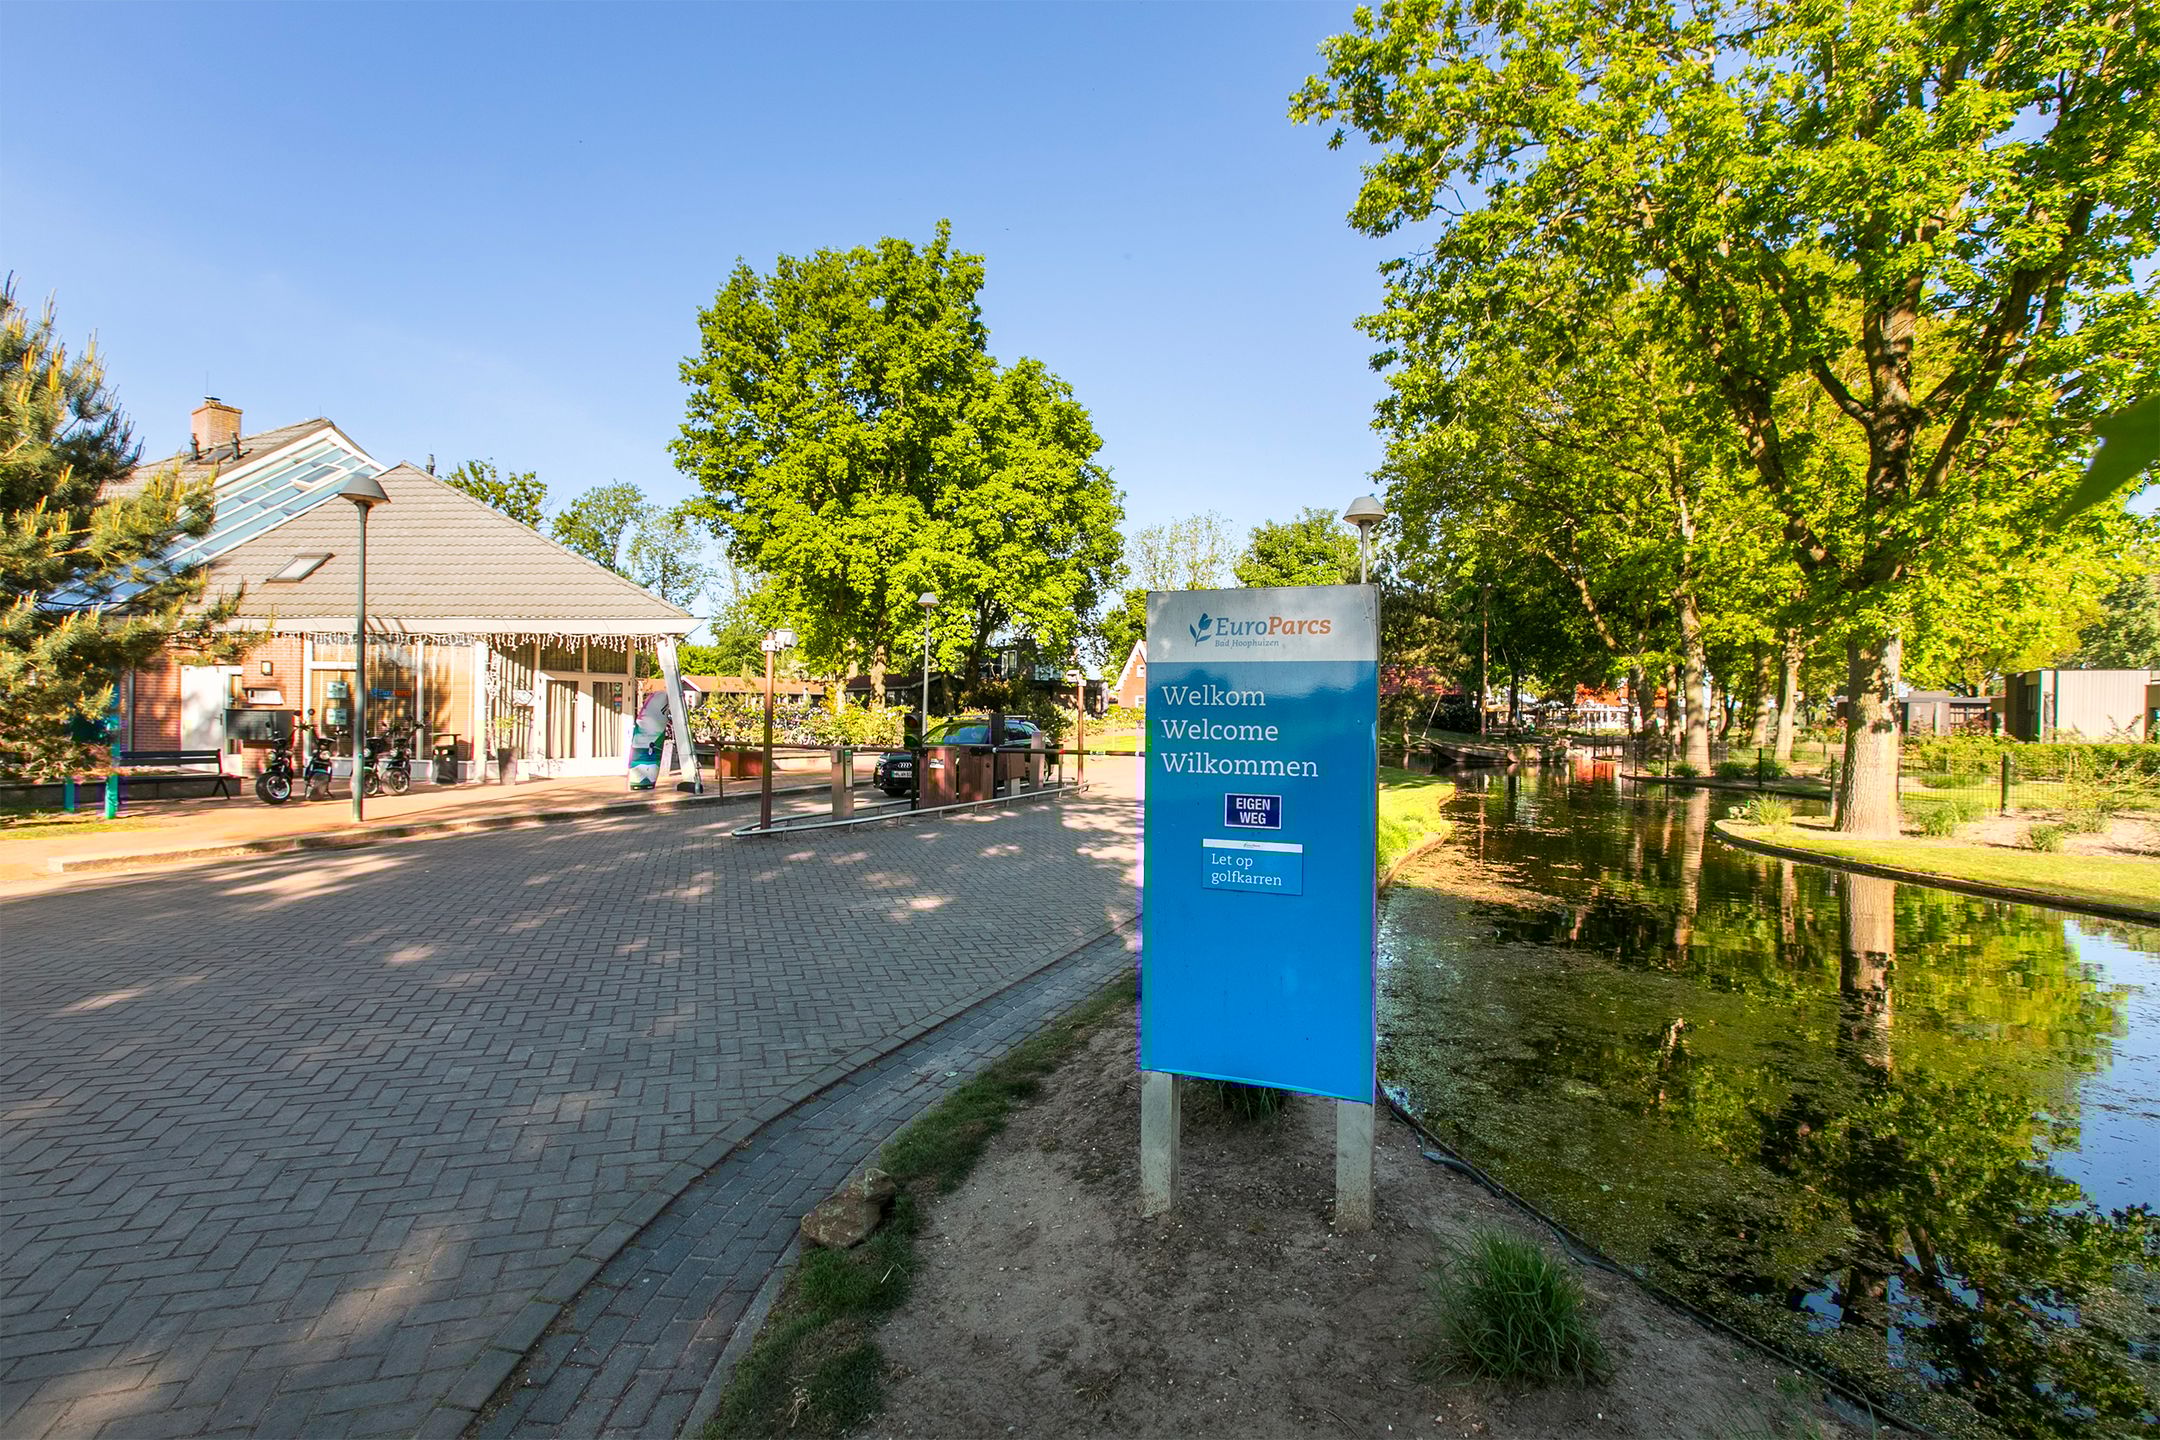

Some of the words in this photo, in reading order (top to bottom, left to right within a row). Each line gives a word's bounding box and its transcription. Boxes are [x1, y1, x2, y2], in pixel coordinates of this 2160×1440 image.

[1215, 616, 1331, 636] EuroParcs
[1231, 640, 1279, 649] Hoophuizen
[1162, 684, 1266, 706] Welkom
[1161, 718, 1279, 741] Welcome
[1161, 752, 1319, 777] Wilkommen
[1236, 798, 1271, 811] EIGEN
[1240, 812, 1266, 824] WEG
[1211, 853, 1232, 865] Let
[1236, 857, 1253, 870] op
[1211, 870, 1282, 886] golfkarren
